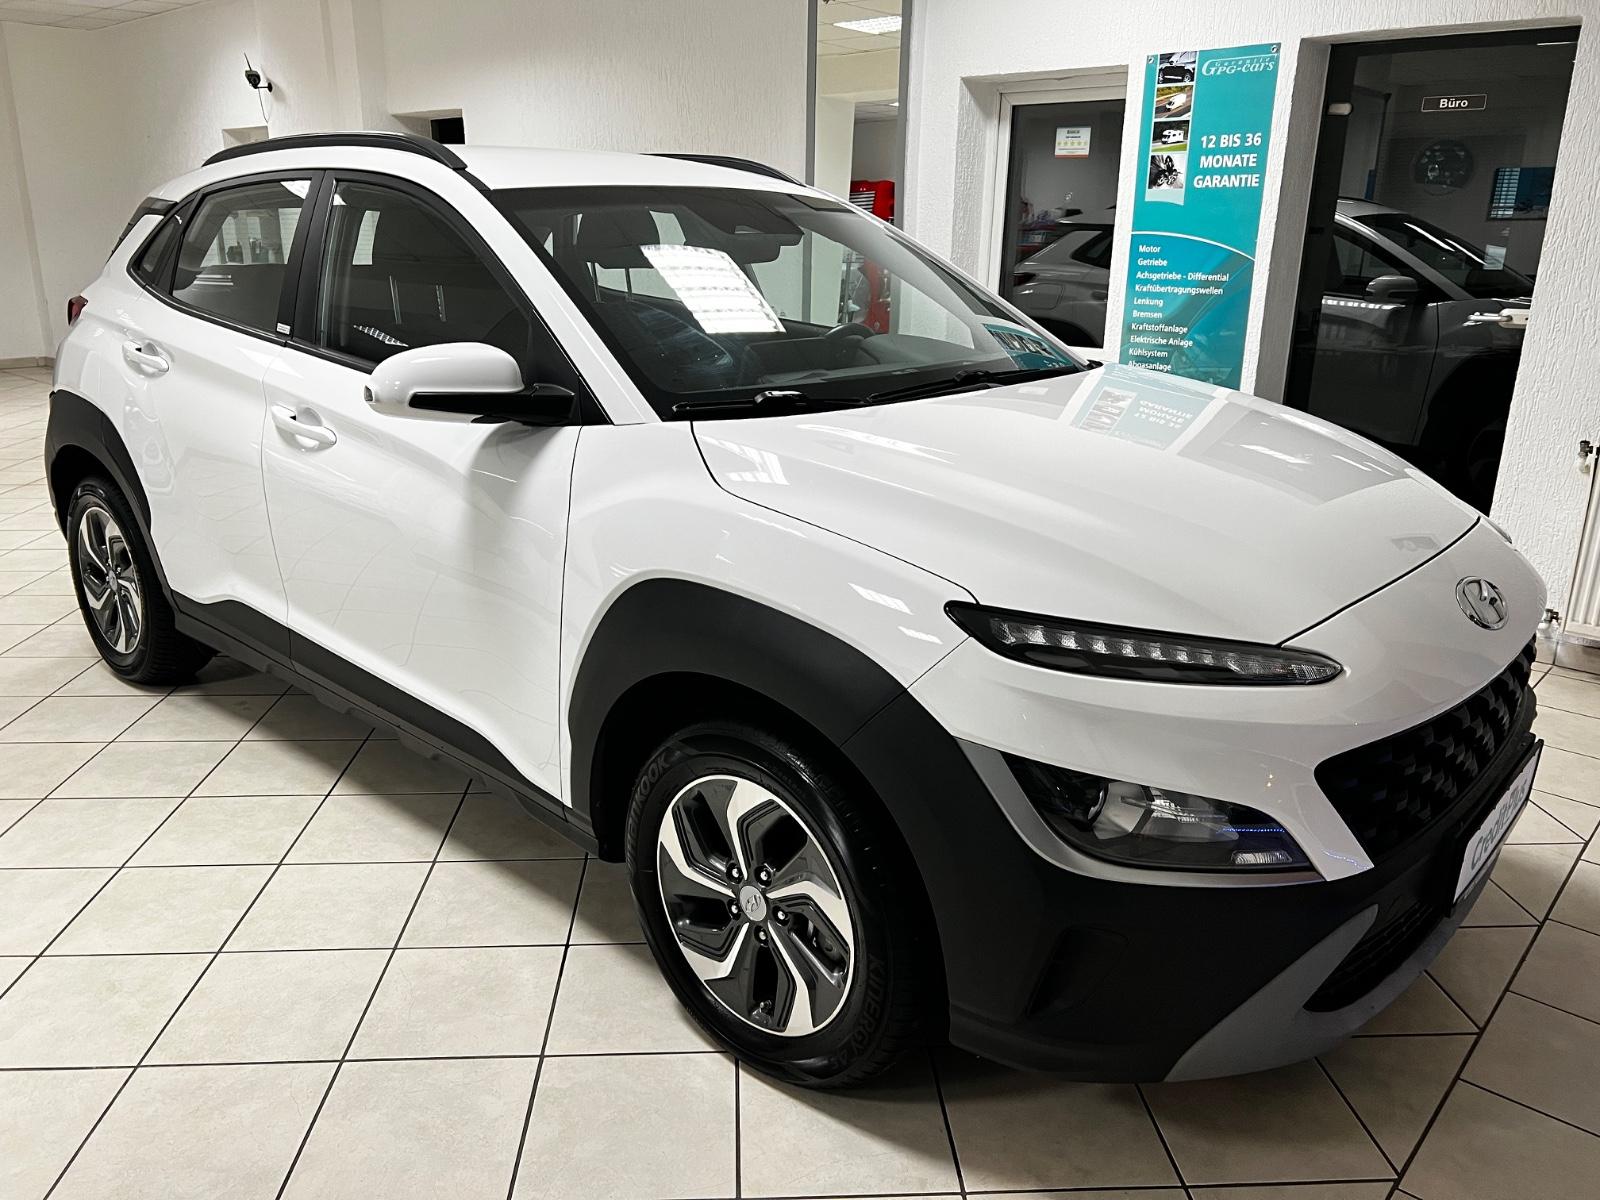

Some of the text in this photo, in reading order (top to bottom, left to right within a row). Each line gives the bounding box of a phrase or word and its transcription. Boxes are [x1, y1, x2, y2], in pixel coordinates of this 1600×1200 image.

[1439, 98, 1469, 109] Büro
[1201, 132, 1262, 149] 12 BIS 36
[1200, 153, 1257, 169] MONATE
[1193, 174, 1260, 189] GARANTIE
[1139, 245, 1161, 253] Motor
[1137, 258, 1168, 267] Getriebe
[1136, 271, 1182, 282] Achsgetriebe
[1187, 272, 1230, 282] Differential
[1135, 284, 1224, 296] Kraftübertragungswellen
[1133, 297, 1164, 307] Lenkung
[1132, 310, 1163, 319] Bremsen
[1131, 323, 1188, 335] Kraftstoffanlage
[1130, 335, 1194, 348] Elektrische Anlage
[1129, 347, 1168, 358] Kühlsystem
